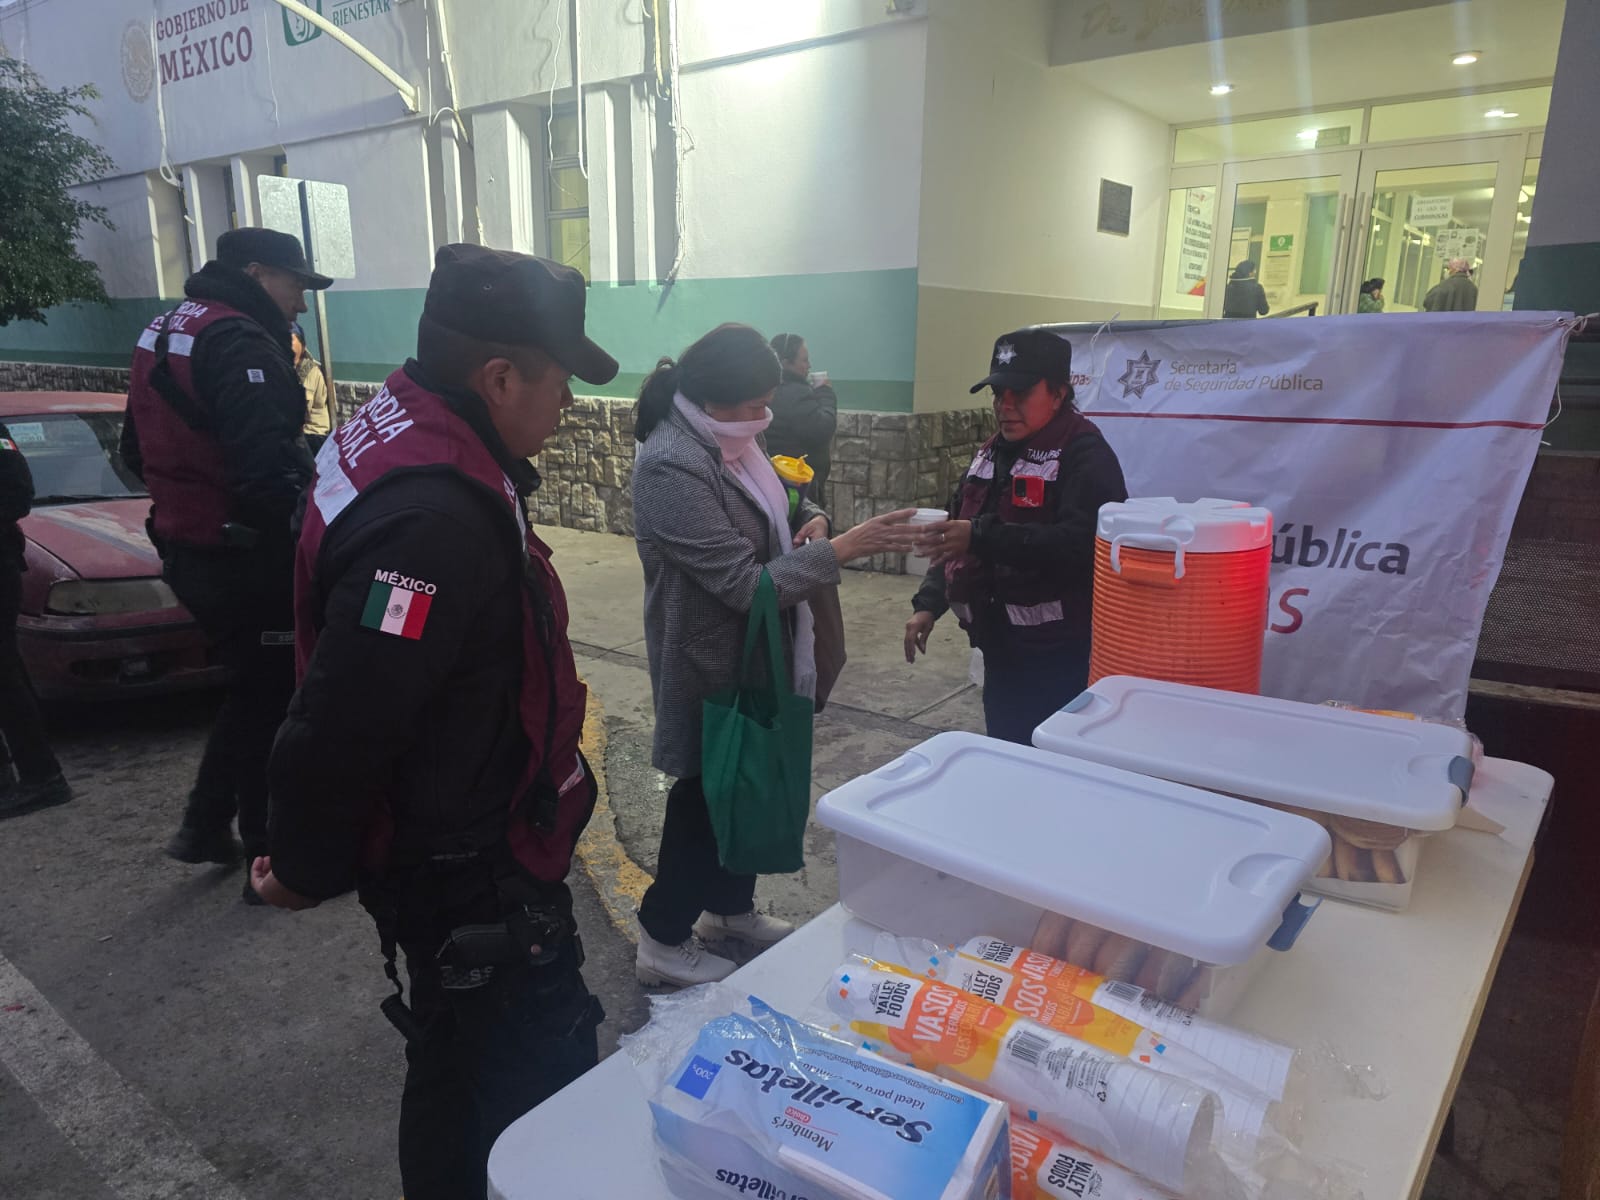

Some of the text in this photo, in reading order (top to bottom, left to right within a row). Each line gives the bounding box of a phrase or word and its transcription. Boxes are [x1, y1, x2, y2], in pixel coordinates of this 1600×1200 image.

[156, 0, 249, 41] GOBIERNO DE
[332, 0, 391, 27] BIENESTAR
[159, 26, 253, 86] MÉXICO
[1164, 374, 1324, 394] de Seguridad Pública
[1169, 358, 1237, 376] Secretaría
[1271, 523, 1410, 575] ública
[374, 569, 437, 595] MÉXICO
[1264, 586, 1310, 634] S
[875, 979, 898, 1015] VALLEY
[887, 982, 912, 1018] FOODS
[912, 984, 959, 1043] VASOS
[1014, 978, 1048, 1018] SOS
[724, 1049, 933, 1144] Servilletas
[864, 1083, 894, 1102] para
[894, 1090, 926, 1110] Ideal
[771, 1115, 835, 1152] Member's
[1047, 1153, 1076, 1188] FOODS
[1066, 1160, 1094, 1198] VALLEY
